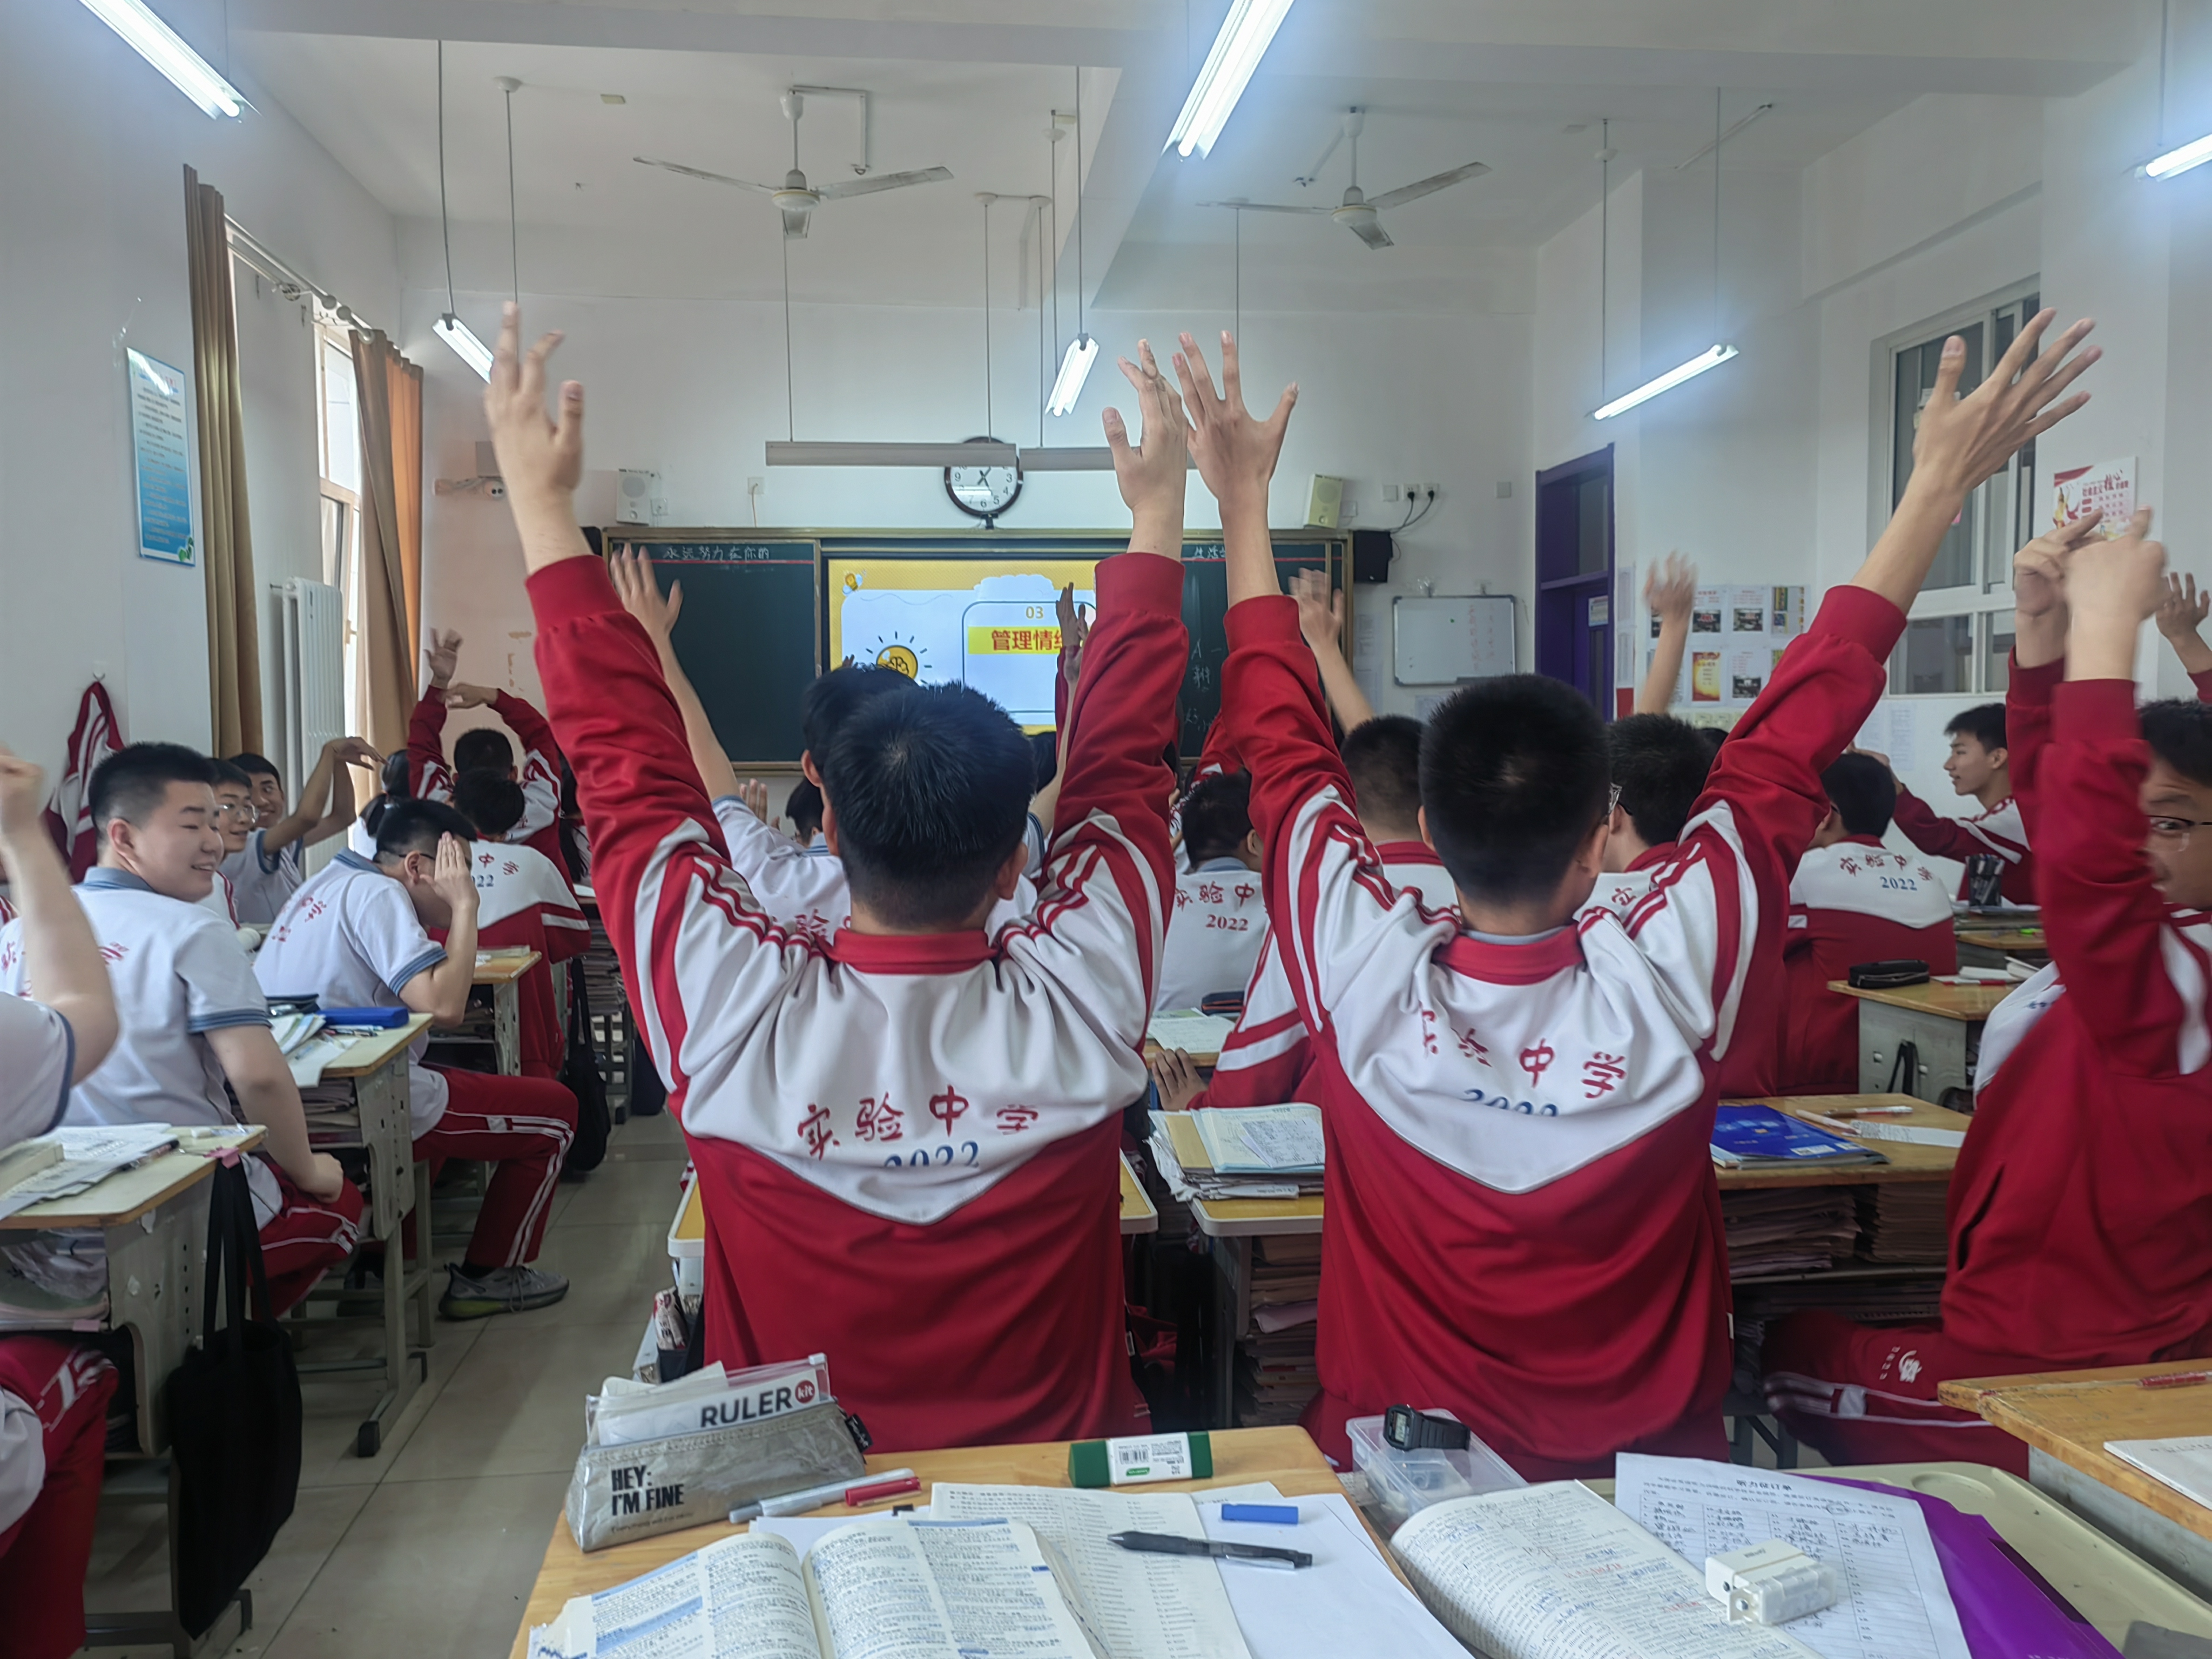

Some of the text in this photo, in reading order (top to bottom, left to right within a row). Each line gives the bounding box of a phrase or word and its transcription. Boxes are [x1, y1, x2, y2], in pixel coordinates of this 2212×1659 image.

[954, 472, 961, 481] 9
[1006, 473, 1013, 483] 3
[1003, 487, 1009, 495] 4
[980, 498, 987, 508] 6
[993, 495, 1000, 505] 5
[1026, 606, 1044, 619] 03
[1839, 854, 1934, 882] 实验中学
[1879, 876, 1918, 892] 2022
[1175, 880, 1269, 914] 实验中
[1205, 914, 1249, 931] 2022
[797, 1083, 1040, 1161] 实验中学
[700, 1384, 814, 1428] RULER kit
[611, 1464, 653, 1492] HEY:
[611, 1483, 684, 1516] I'M FINE
